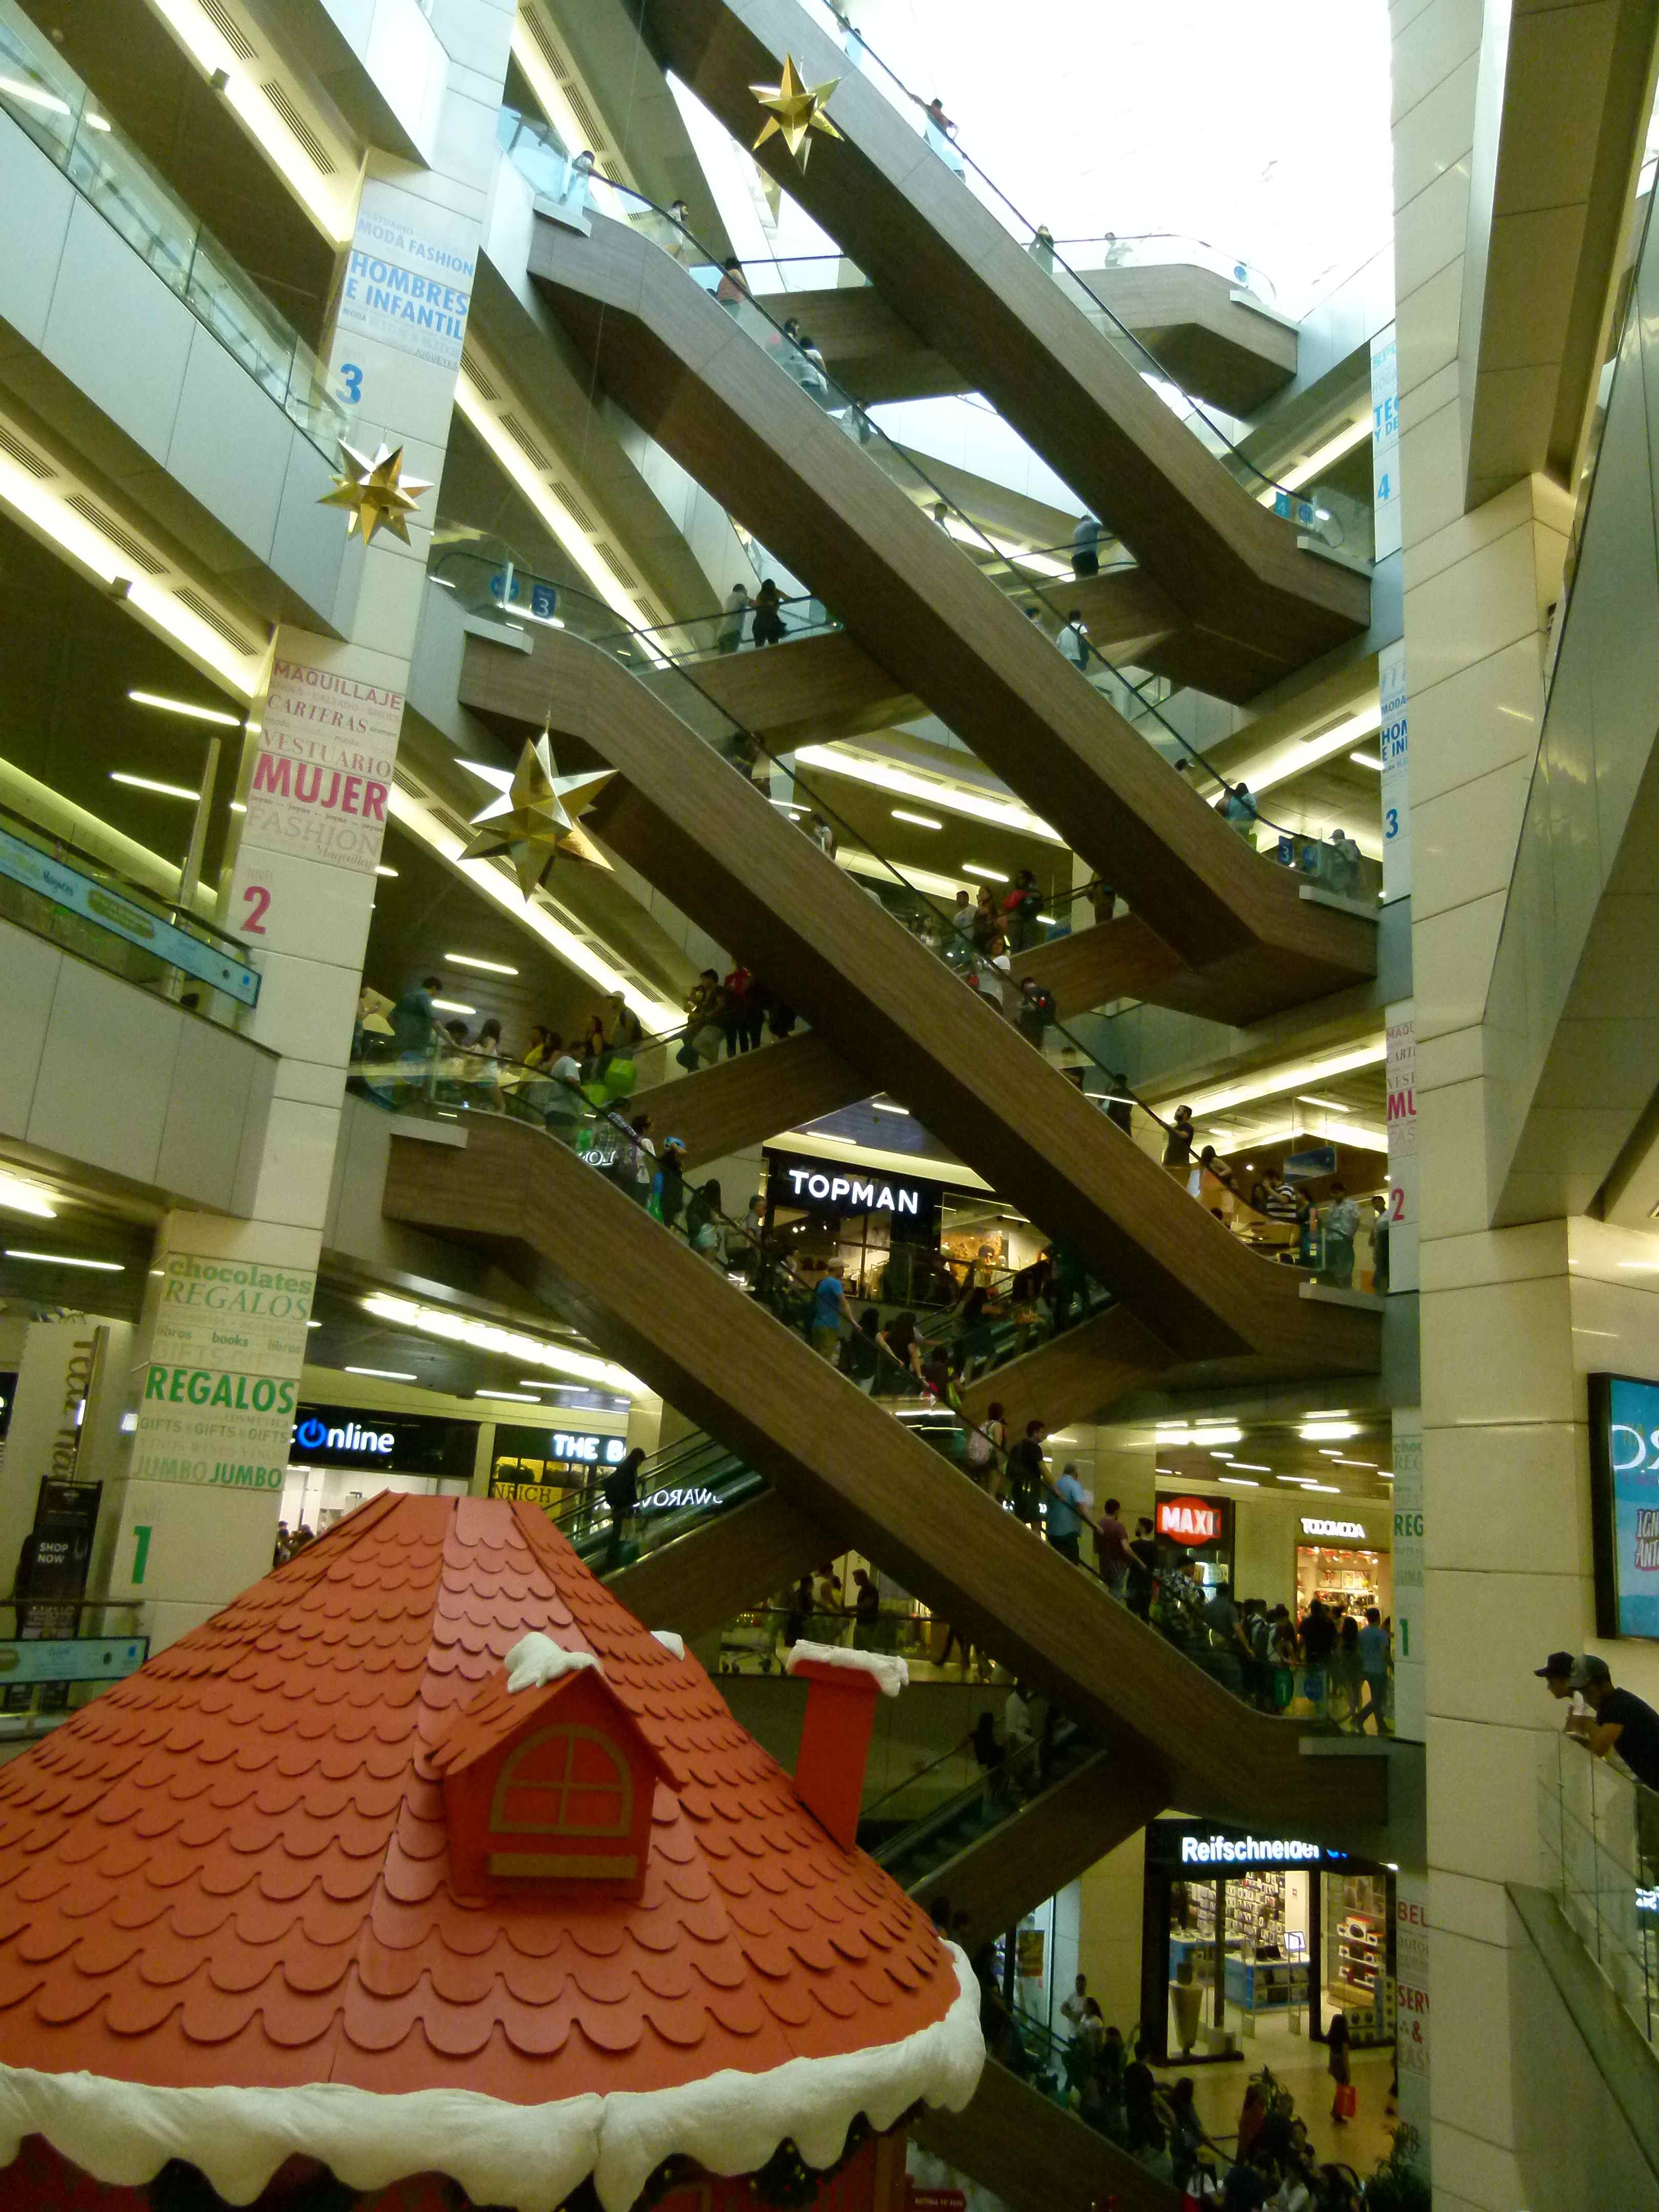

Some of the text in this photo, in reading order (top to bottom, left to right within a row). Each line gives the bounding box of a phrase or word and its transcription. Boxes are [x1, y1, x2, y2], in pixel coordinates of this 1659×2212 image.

[357, 218, 474, 277] MODA FASHION
[351, 250, 469, 316] HOMBRES
[346, 278, 463, 341] E INFANTIL
[336, 363, 363, 405] 3
[1377, 473, 1391, 500] 4
[537, 598, 549, 616] 3
[274, 662, 402, 711] MAQUILLAJE
[1381, 695, 1406, 715] MODA
[268, 694, 369, 734] CARTERAS
[264, 728, 391, 778] VESTUARIO
[252, 753, 390, 822] MUJER
[248, 807, 382, 857] FASHION
[1386, 807, 1399, 839] 3
[1281, 845, 1290, 862] 3
[240, 886, 271, 935] 2
[789, 1169, 919, 1215] TOPMAN
[1391, 1187, 1405, 1222] 2
[168, 1256, 314, 1296] chocolates
[163, 1280, 308, 1321] REGALOS
[211, 1331, 249, 1348] books
[145, 1364, 295, 1415] REGALOS
[139, 1417, 289, 1443] GIFTS GIFTS GIFTS
[290, 1418, 395, 1453] Online
[553, 1434, 626, 1462] THE B
[209, 1462, 283, 1488] JUMBO
[40, 1542, 69, 1552] SHOP
[1300, 1518, 1365, 1539] TODOMODA
[37, 1554, 66, 1564] NOW
[132, 1525, 152, 1584] 1
[1399, 1618, 1409, 1656] 1
[1412, 2020, 1423, 2045] &
